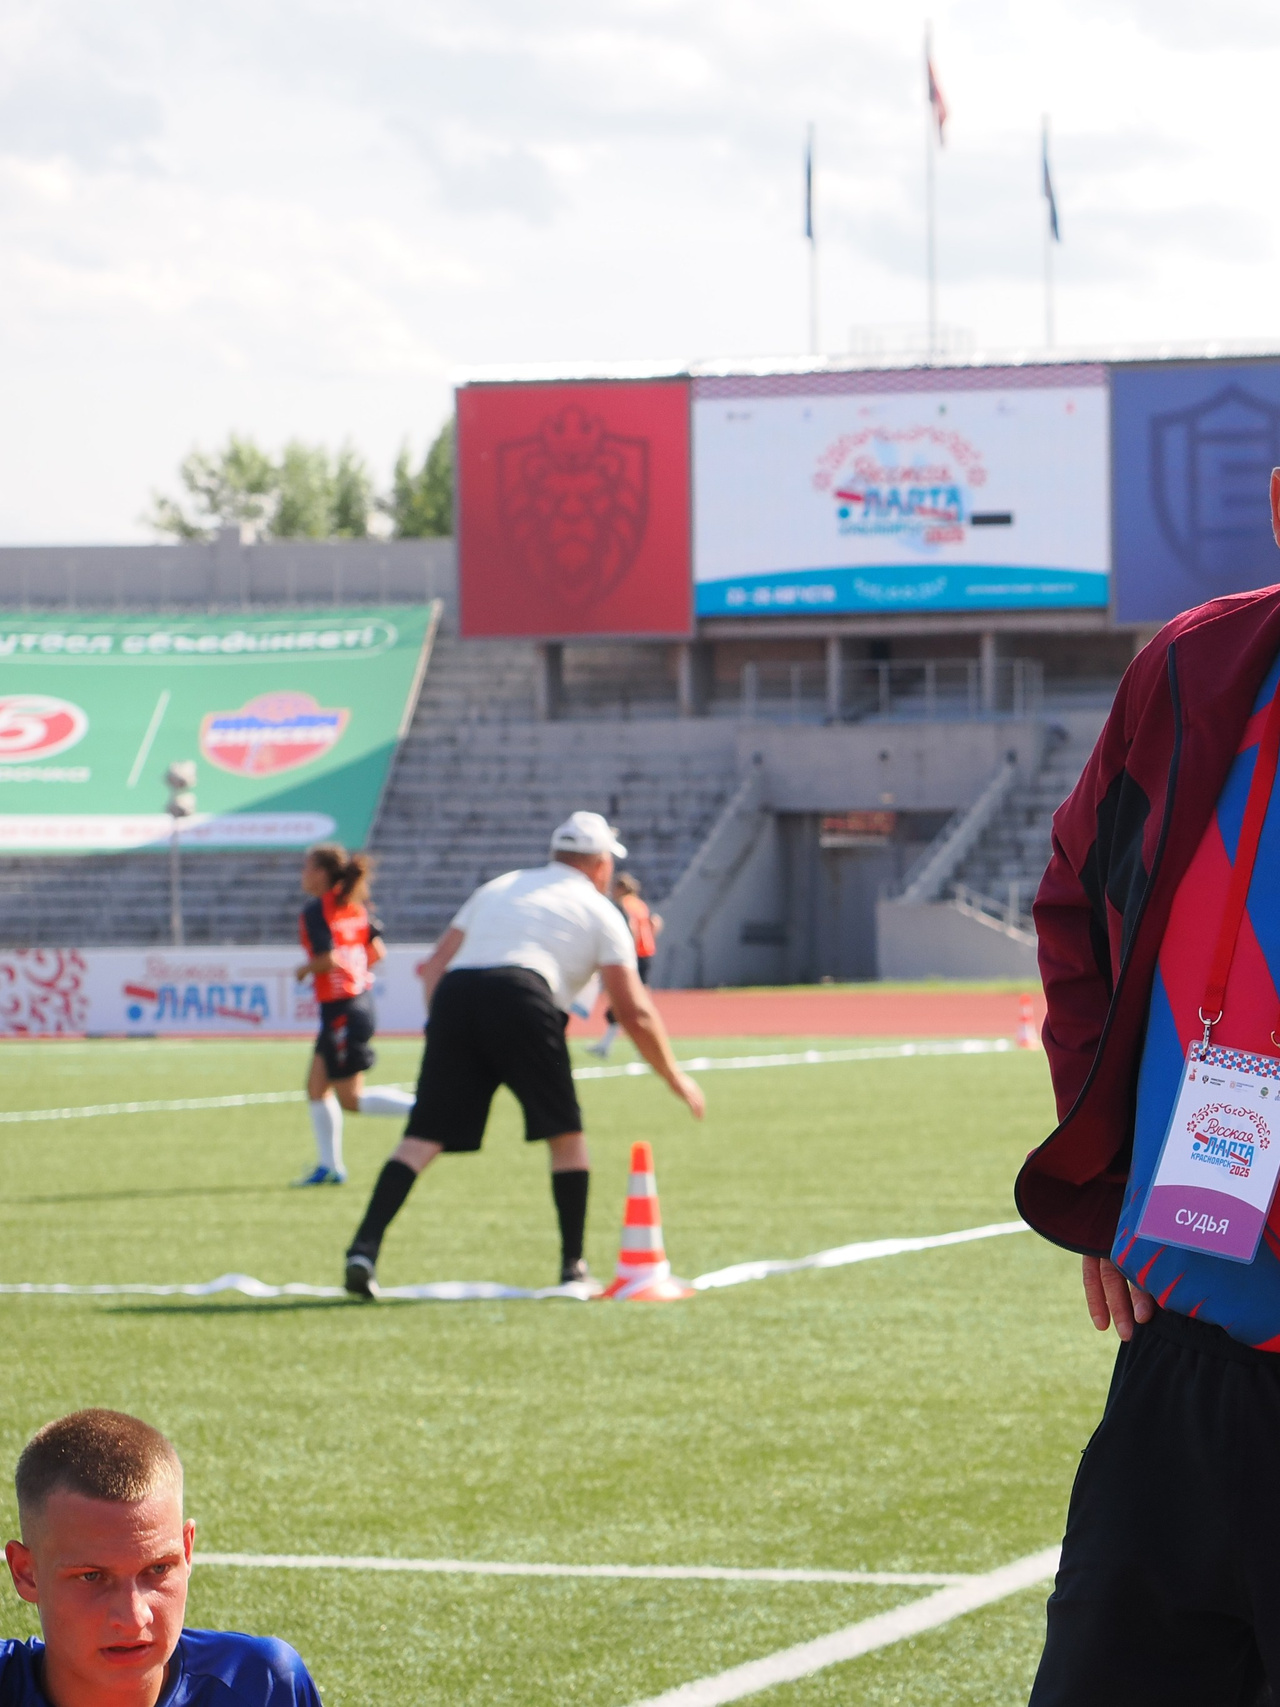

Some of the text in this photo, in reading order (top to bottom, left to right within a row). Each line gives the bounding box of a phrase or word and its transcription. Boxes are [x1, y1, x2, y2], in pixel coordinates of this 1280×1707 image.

[155, 983, 269, 1021] ЛАПТА
[1203, 1117, 1255, 1144] Русская
[1190, 1151, 1231, 1169] КРАСНОЯРСК
[1203, 1136, 1255, 1168] ЛАПТА
[1229, 1164, 1250, 1178] 2025
[1175, 1208, 1230, 1235] СУДЬЯ
